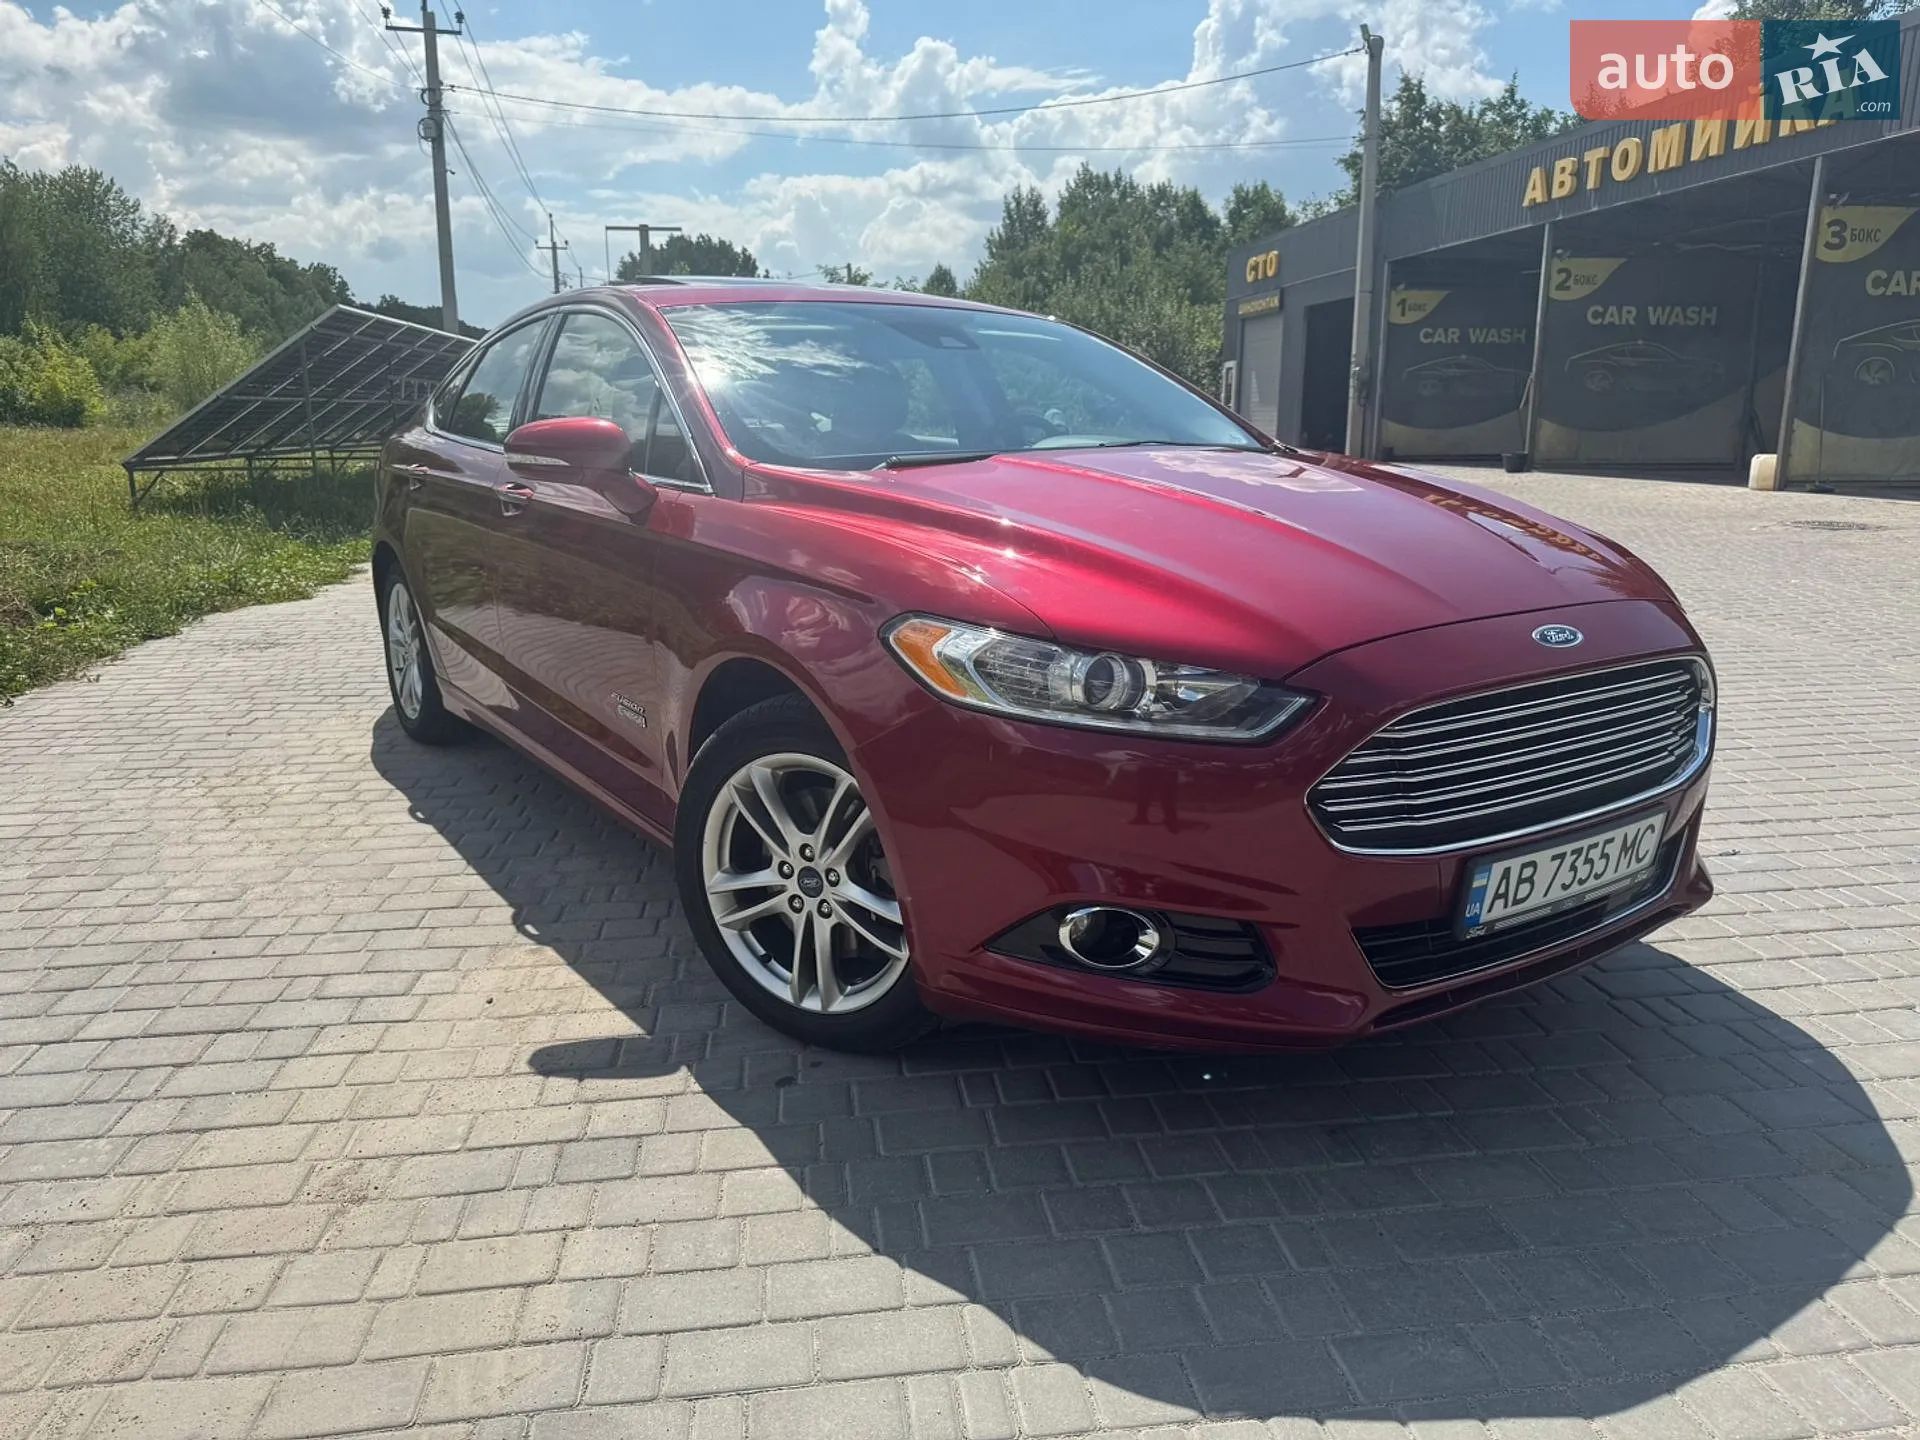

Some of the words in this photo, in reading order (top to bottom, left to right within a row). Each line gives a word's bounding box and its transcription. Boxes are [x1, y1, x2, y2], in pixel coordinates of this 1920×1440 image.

[1823, 218, 1847, 251] 3
[1849, 228, 1881, 243] БОКС
[1246, 249, 1279, 283] СТО
[1555, 267, 1572, 291] 2
[1573, 273, 1598, 286] БОКС
[1396, 298, 1407, 317] 1
[1586, 305, 1637, 325] CAR
[1648, 306, 1718, 326] WASH
[1419, 327, 1460, 344] CAR
[1468, 327, 1526, 344] WASH
[1486, 860, 1538, 914] AB
[1542, 836, 1616, 898] 7355
[1614, 823, 1656, 874] MC
[1465, 902, 1480, 918] UA
